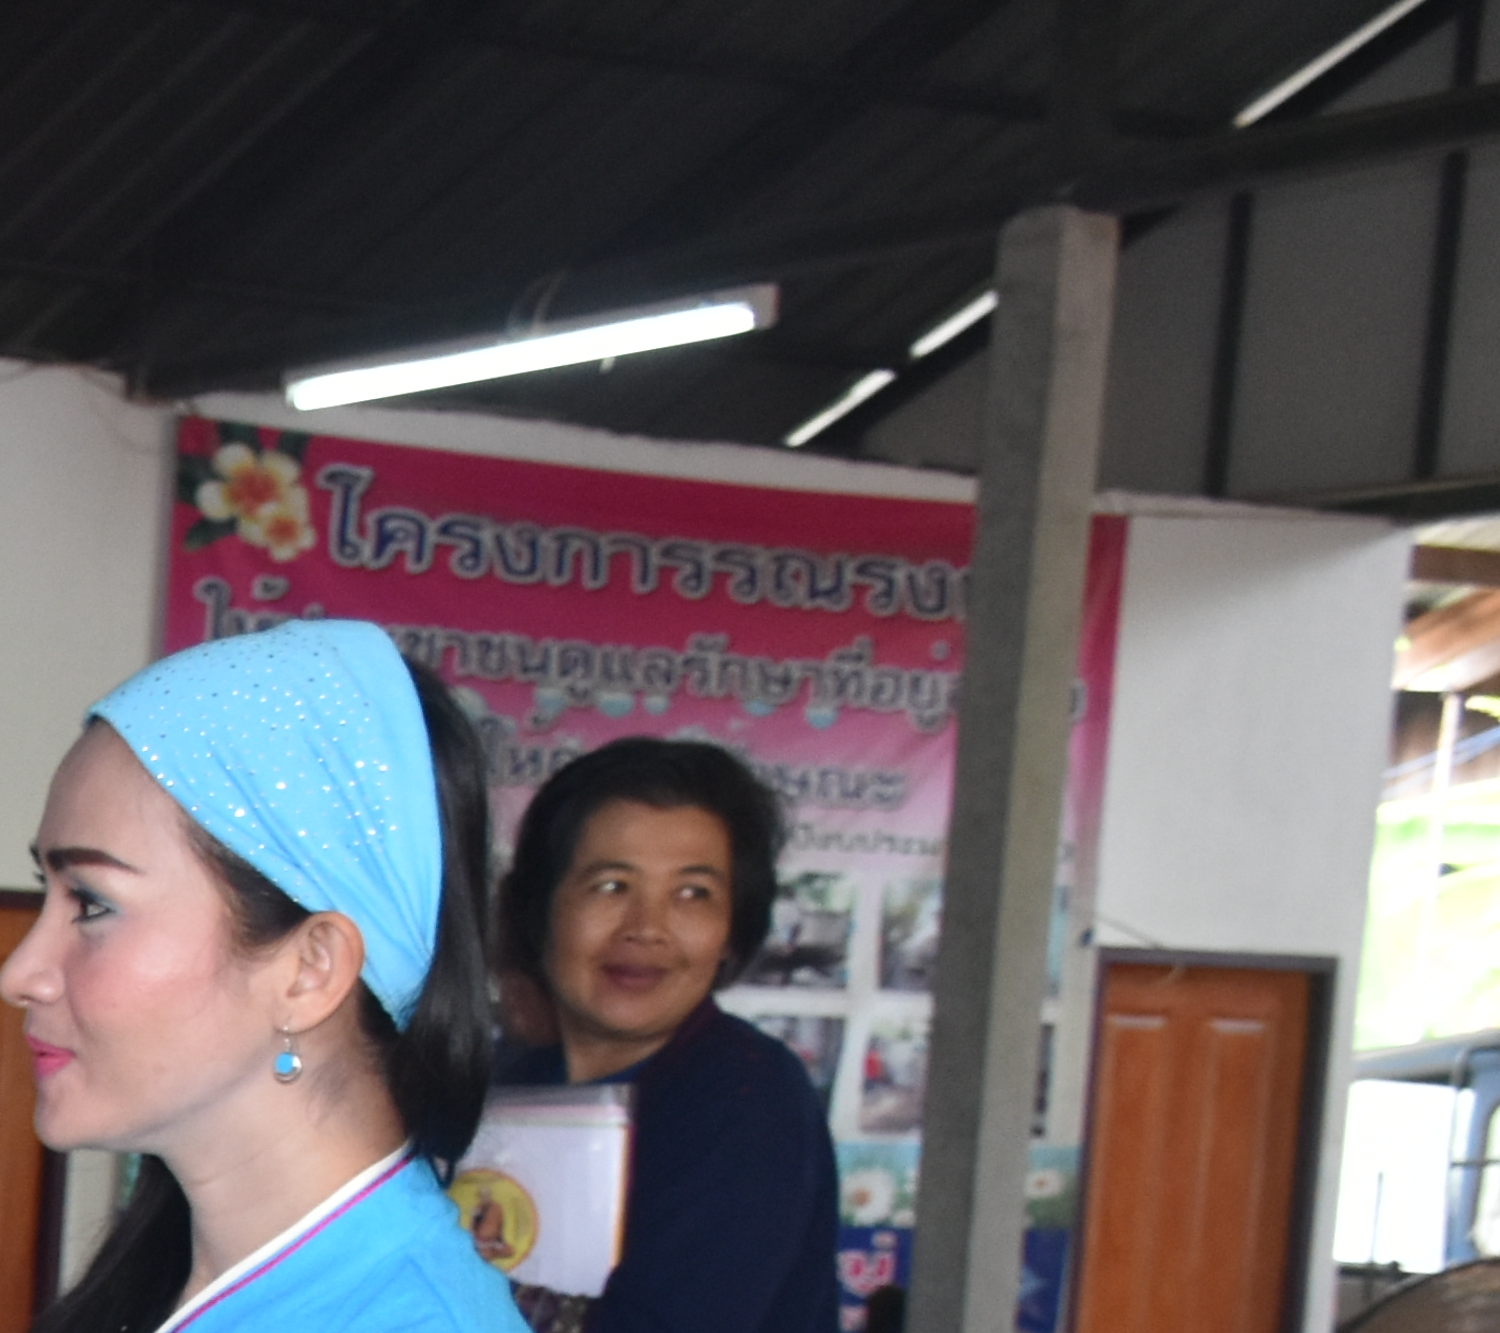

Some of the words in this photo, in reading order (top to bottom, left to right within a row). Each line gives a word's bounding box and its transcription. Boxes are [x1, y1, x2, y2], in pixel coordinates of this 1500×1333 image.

[317, 464, 971, 621] โครงการรณรง
